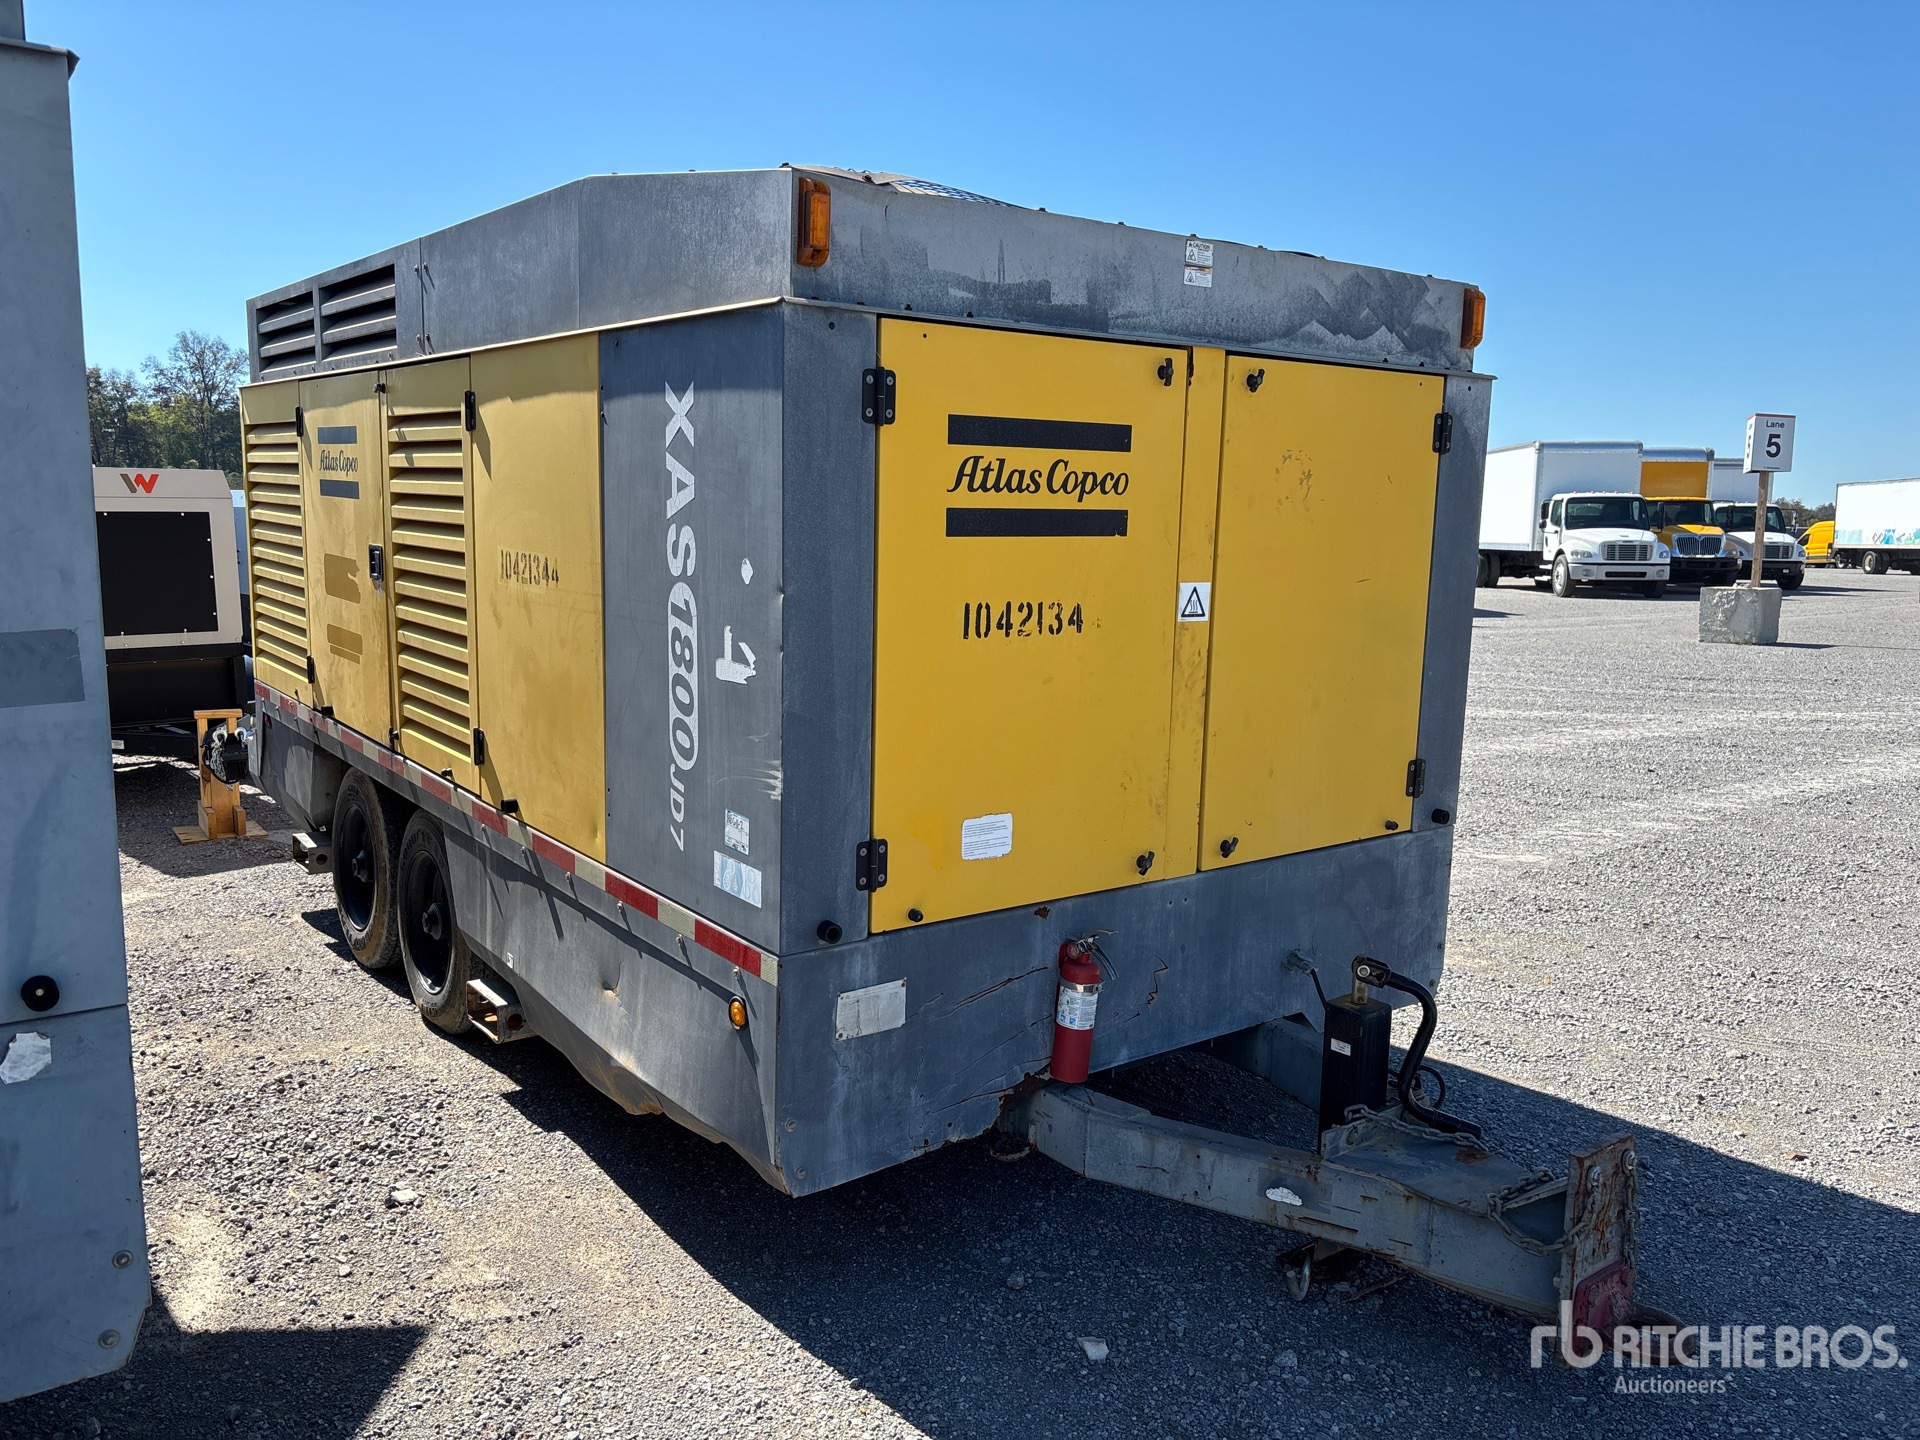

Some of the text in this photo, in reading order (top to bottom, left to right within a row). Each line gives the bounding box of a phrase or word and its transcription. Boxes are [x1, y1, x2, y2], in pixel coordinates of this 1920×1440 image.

[1765, 420, 1785, 428] Lane
[1765, 433, 1781, 458] 5
[319, 449, 359, 477] Atlas Copco
[946, 455, 1129, 503] Atlas Copco
[665, 381, 696, 852] XAS 1800 JD7
[963, 601, 1084, 640] 1042134
